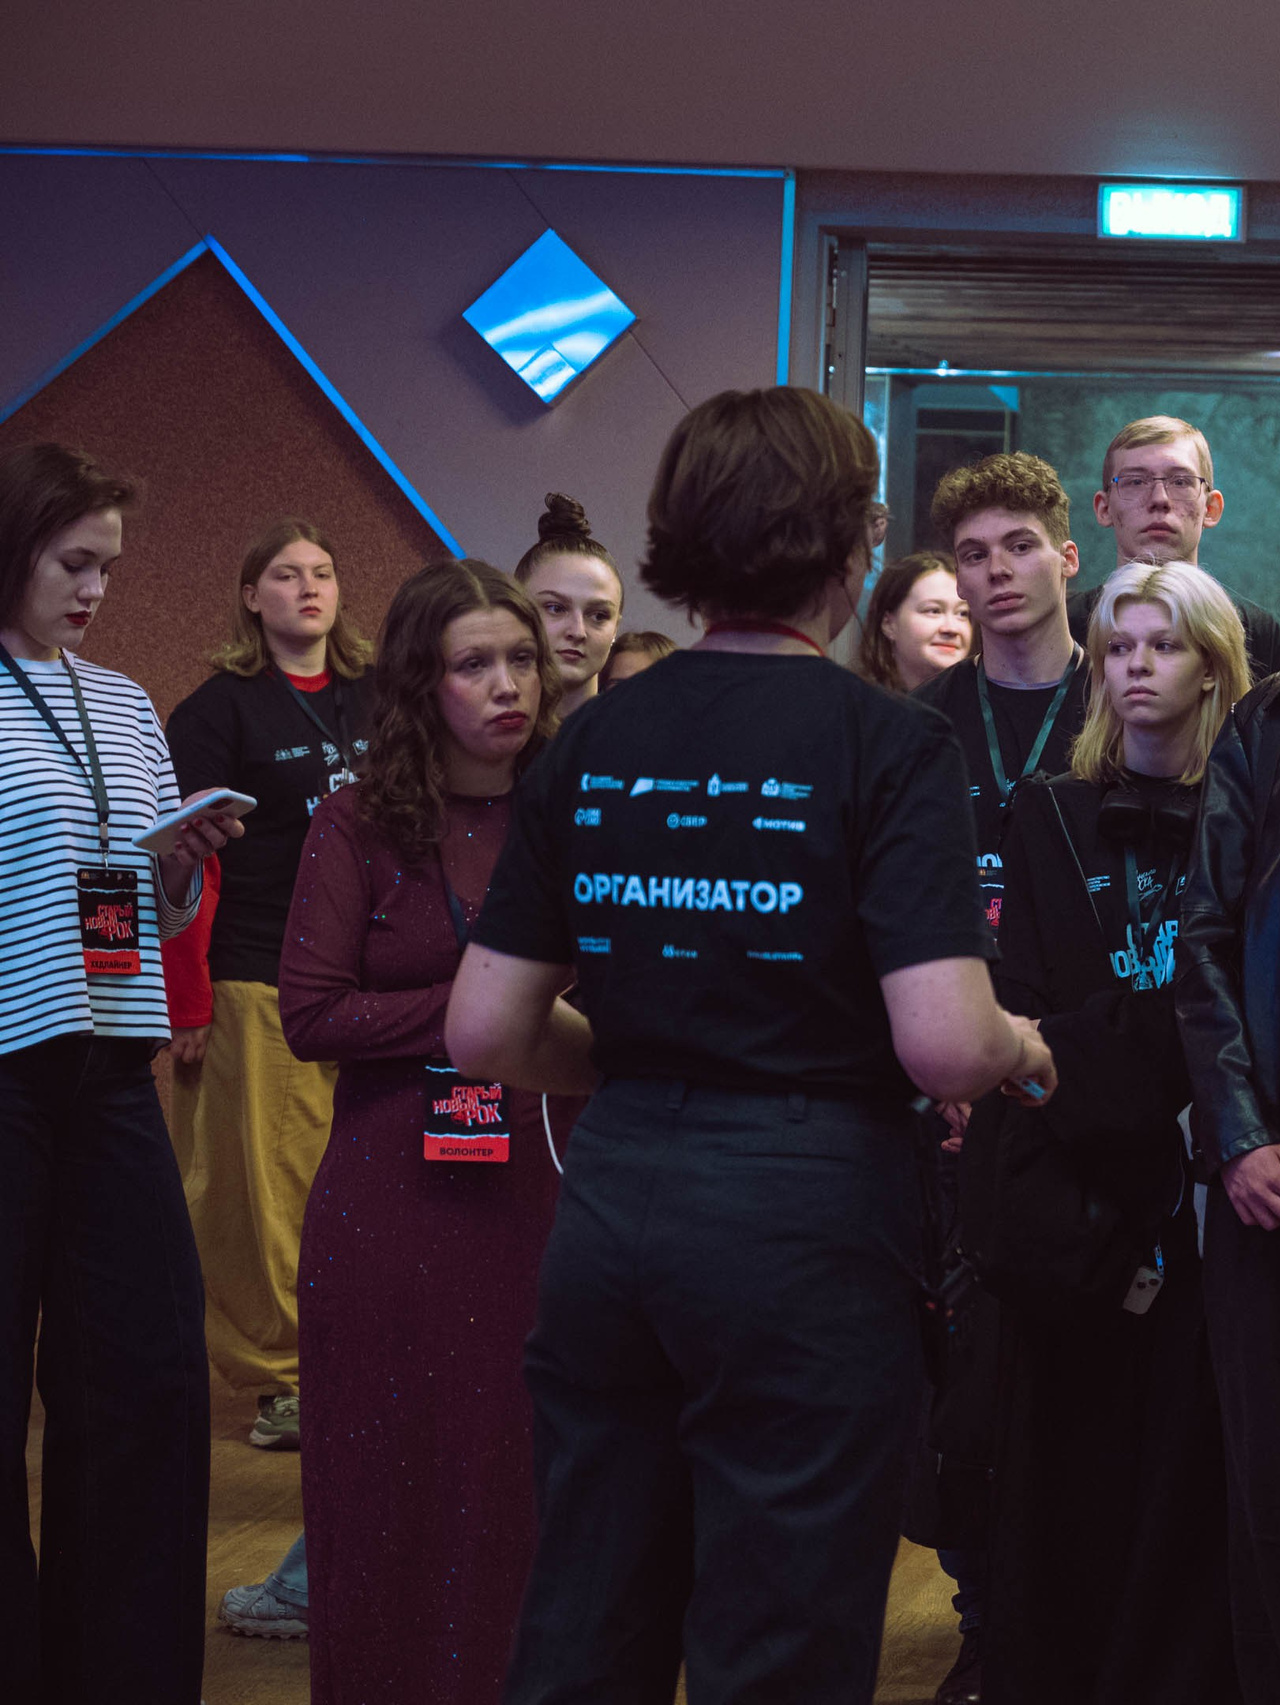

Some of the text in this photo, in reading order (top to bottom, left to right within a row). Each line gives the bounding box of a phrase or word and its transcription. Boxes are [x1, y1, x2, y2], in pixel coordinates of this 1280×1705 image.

[574, 872, 804, 915] ОРГАНИЗАТОР
[97, 902, 134, 918] СТАРЫЙ
[108, 920, 135, 942] РОК
[451, 1082, 503, 1100] СТАРЫЙ
[463, 1102, 503, 1127] РОК
[440, 1147, 494, 1157] ВОЛОНТЕР
